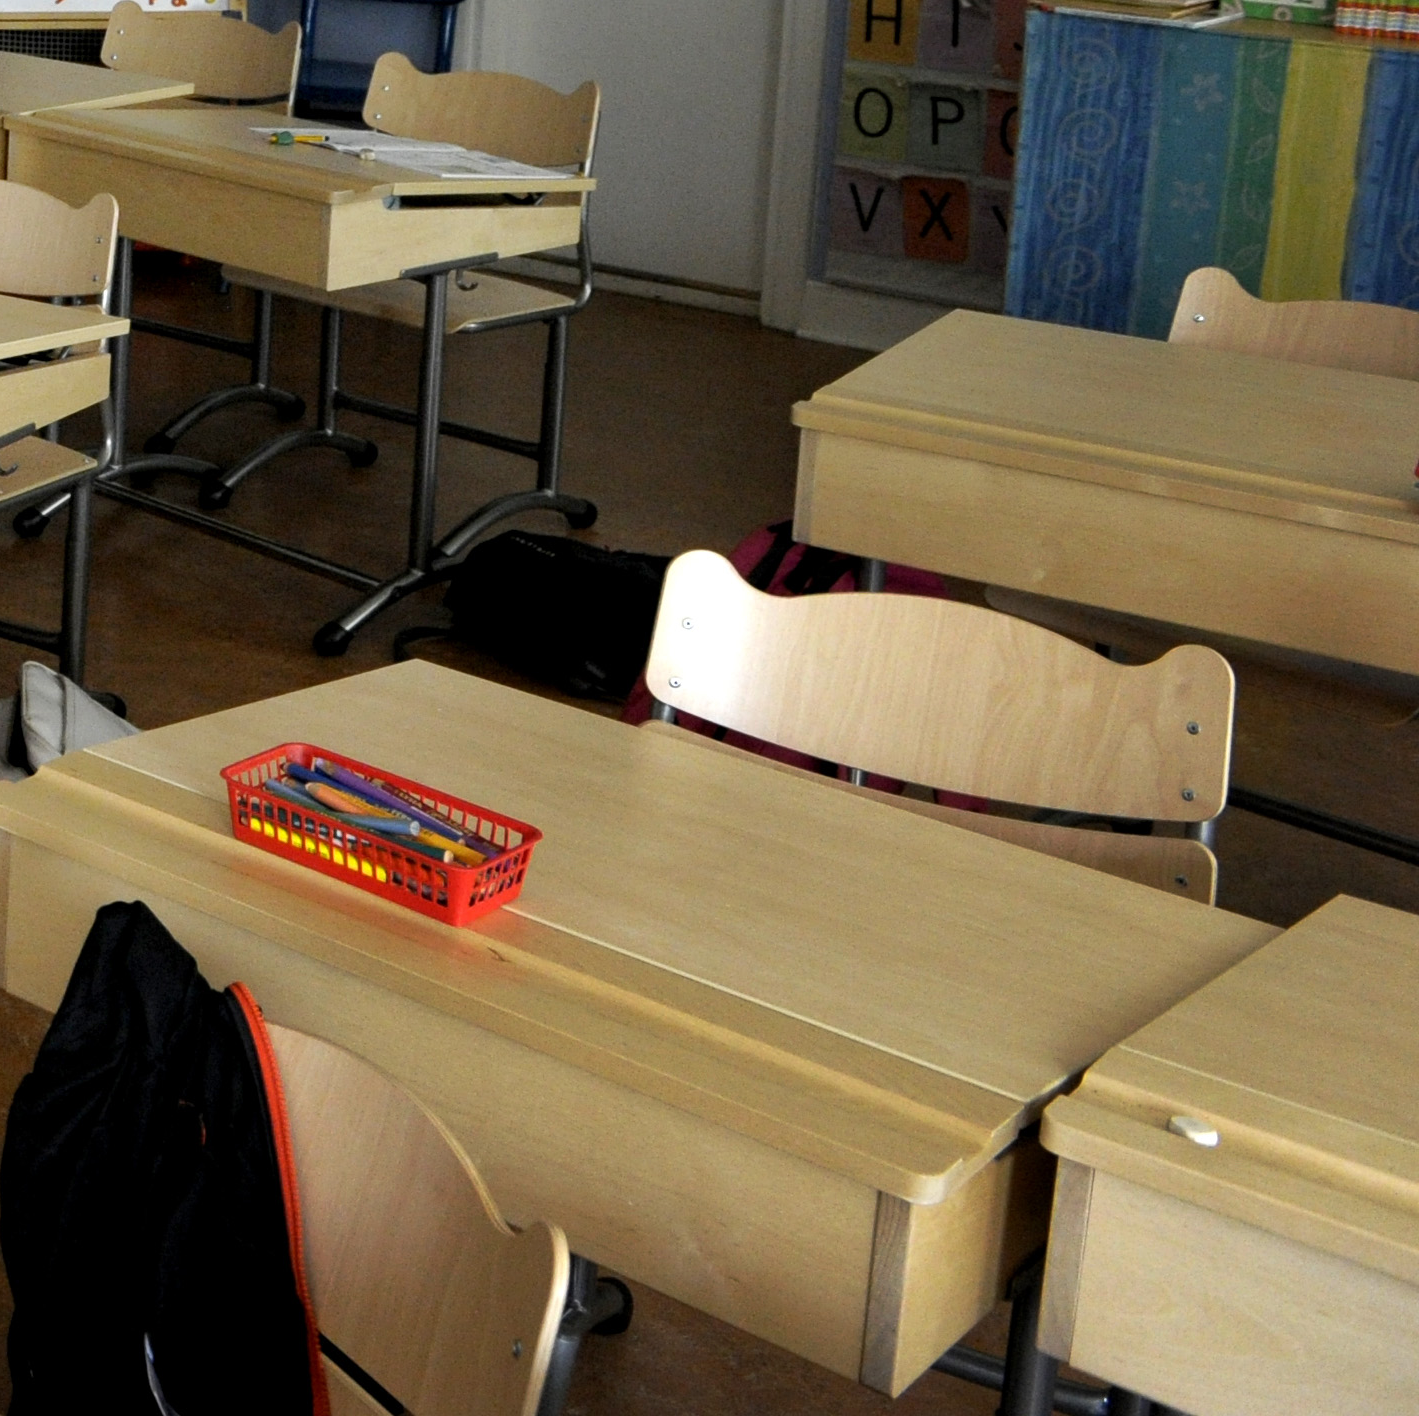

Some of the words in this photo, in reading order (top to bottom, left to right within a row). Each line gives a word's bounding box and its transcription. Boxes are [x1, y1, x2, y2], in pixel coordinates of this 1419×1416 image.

[853, 87, 894, 138] O
[930, 96, 964, 147] P
[849, 183, 884, 233] V
[918, 188, 954, 242] X
